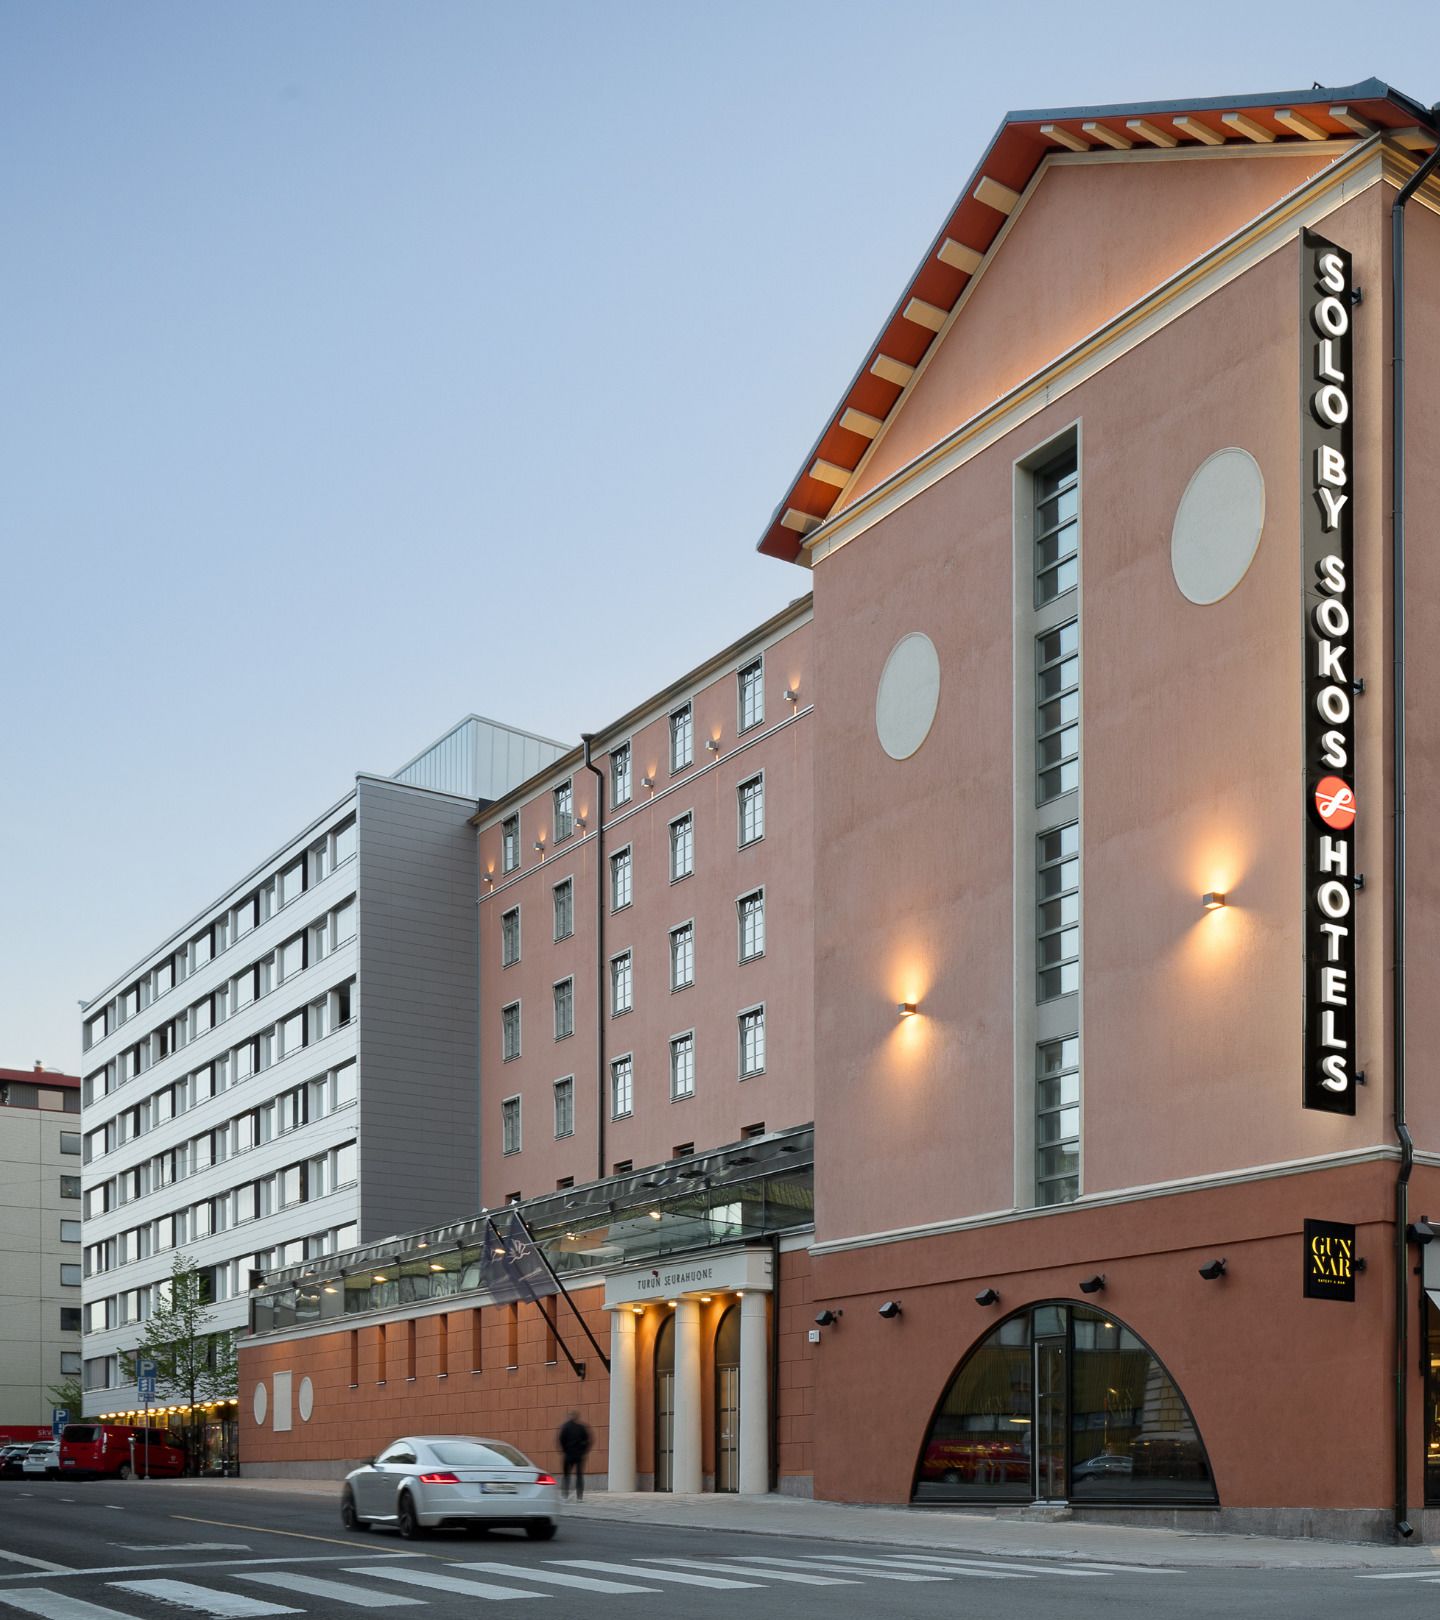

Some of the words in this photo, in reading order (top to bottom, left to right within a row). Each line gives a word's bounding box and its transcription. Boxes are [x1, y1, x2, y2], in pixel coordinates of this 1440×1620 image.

[1315, 254, 1348, 426] SOLO
[1318, 445, 1348, 529] BY
[1316, 554, 1350, 769] SOKOS
[1317, 835, 1350, 1093] HOTELS
[1312, 1236, 1351, 1258] GUN
[1313, 1255, 1351, 1277] NAR
[637, 1277, 661, 1290] TURUN
[664, 1268, 713, 1286] SEURAHUONE
[140, 1361, 154, 1376] P
[55, 1411, 66, 1422] P
